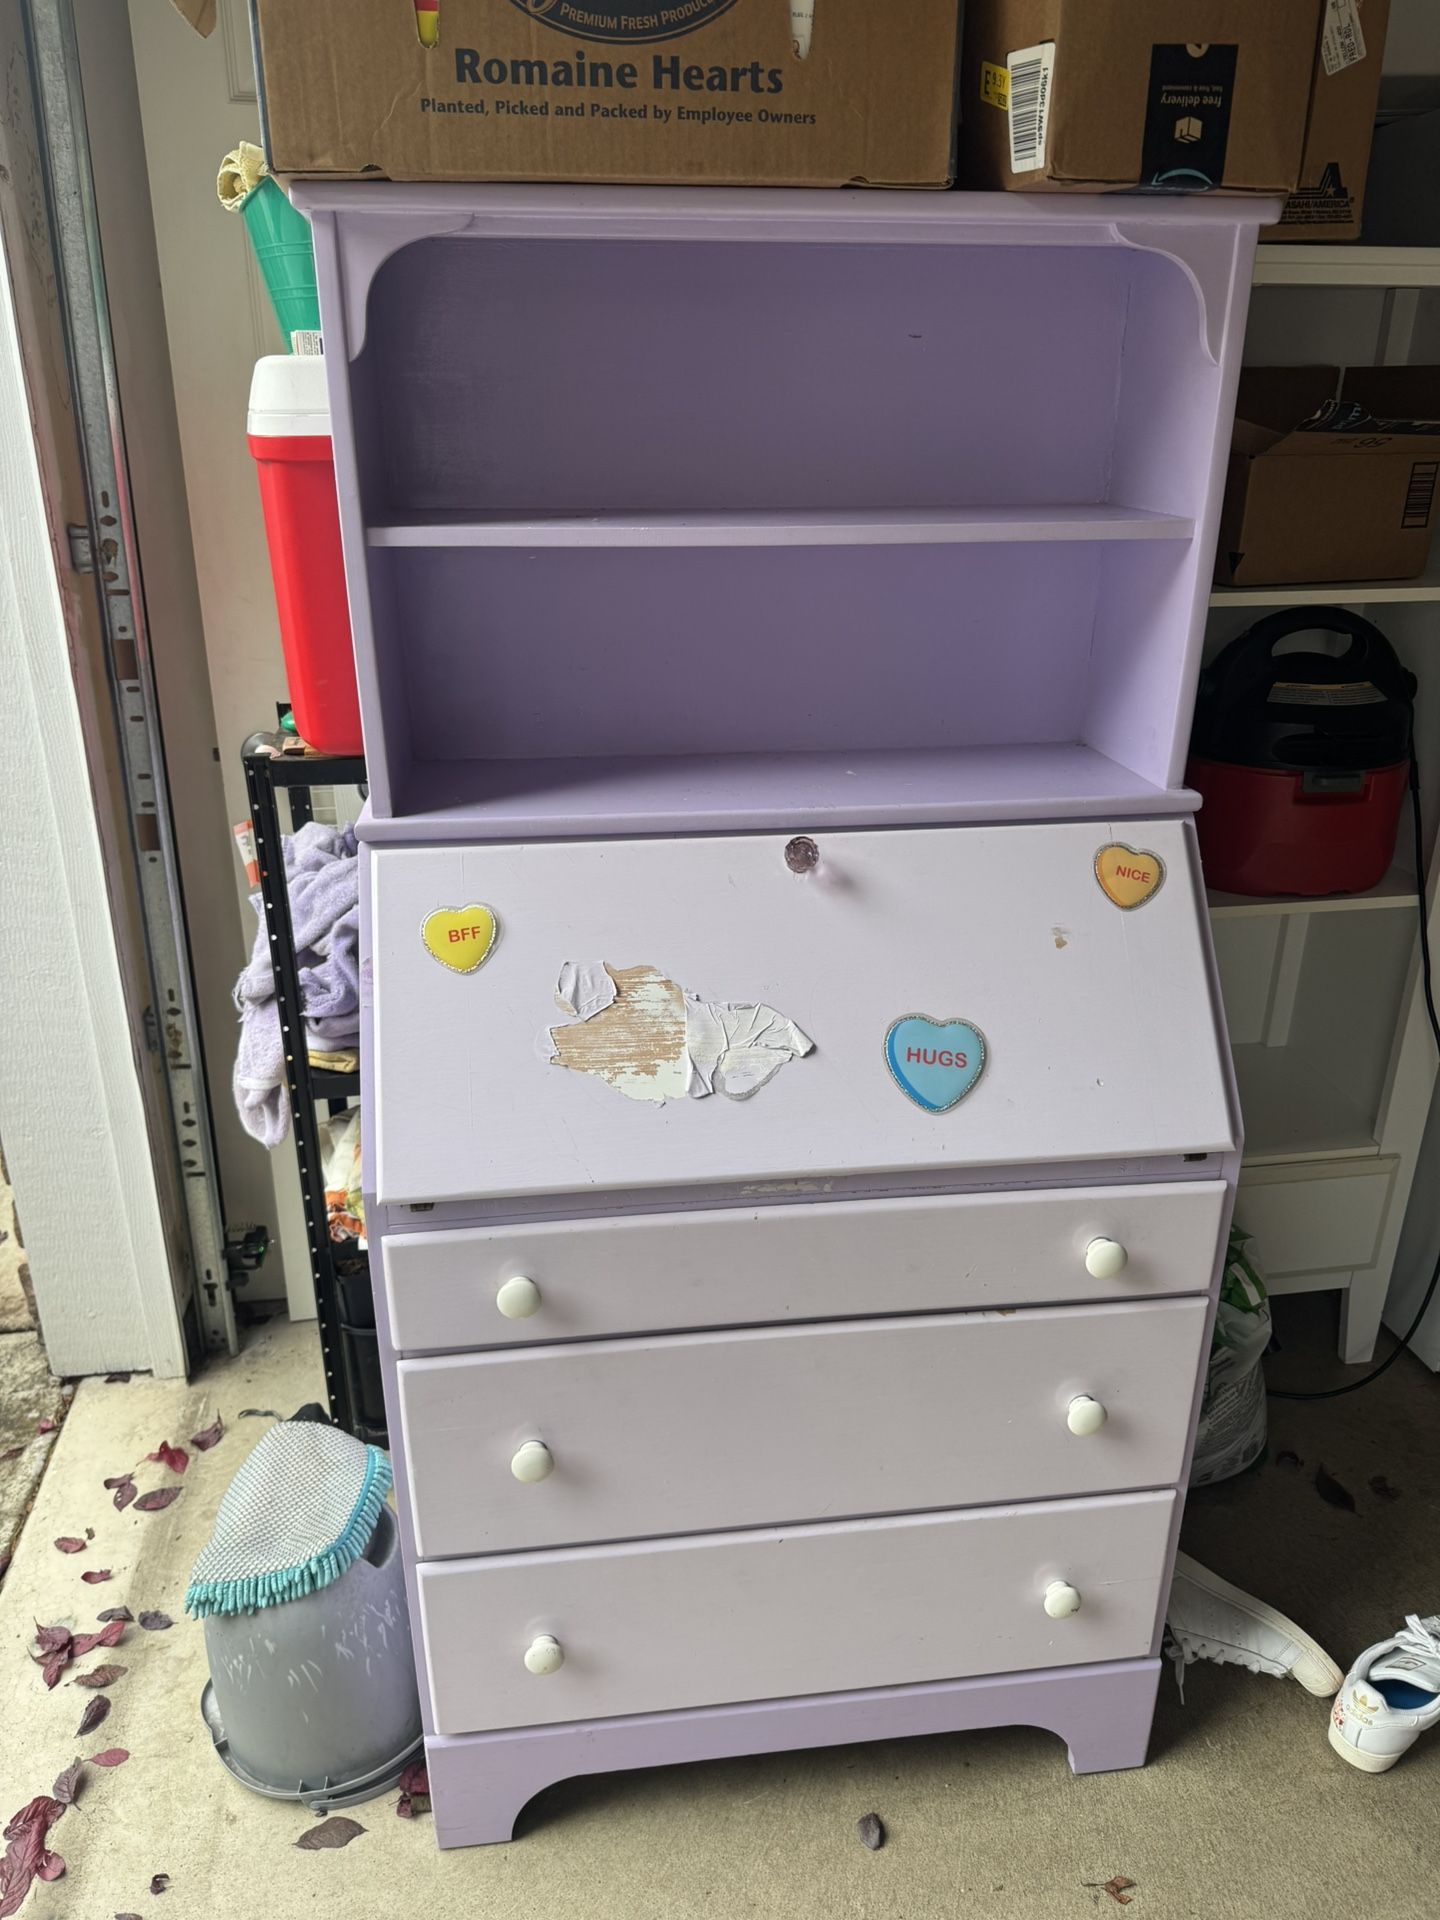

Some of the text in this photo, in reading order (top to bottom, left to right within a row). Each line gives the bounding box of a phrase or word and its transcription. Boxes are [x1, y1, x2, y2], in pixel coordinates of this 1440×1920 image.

[559, 0, 714, 30] PREMIUM FRESH PRODUC
[455, 48, 784, 94] Romaine Hearts
[421, 98, 817, 125] Planted, Picked and Packed by Employee Owners
[1160, 92, 1222, 108] free delivery
[1115, 865, 1151, 884] NICE
[448, 926, 481, 944] BFF
[905, 1047, 968, 1070] HUGS
